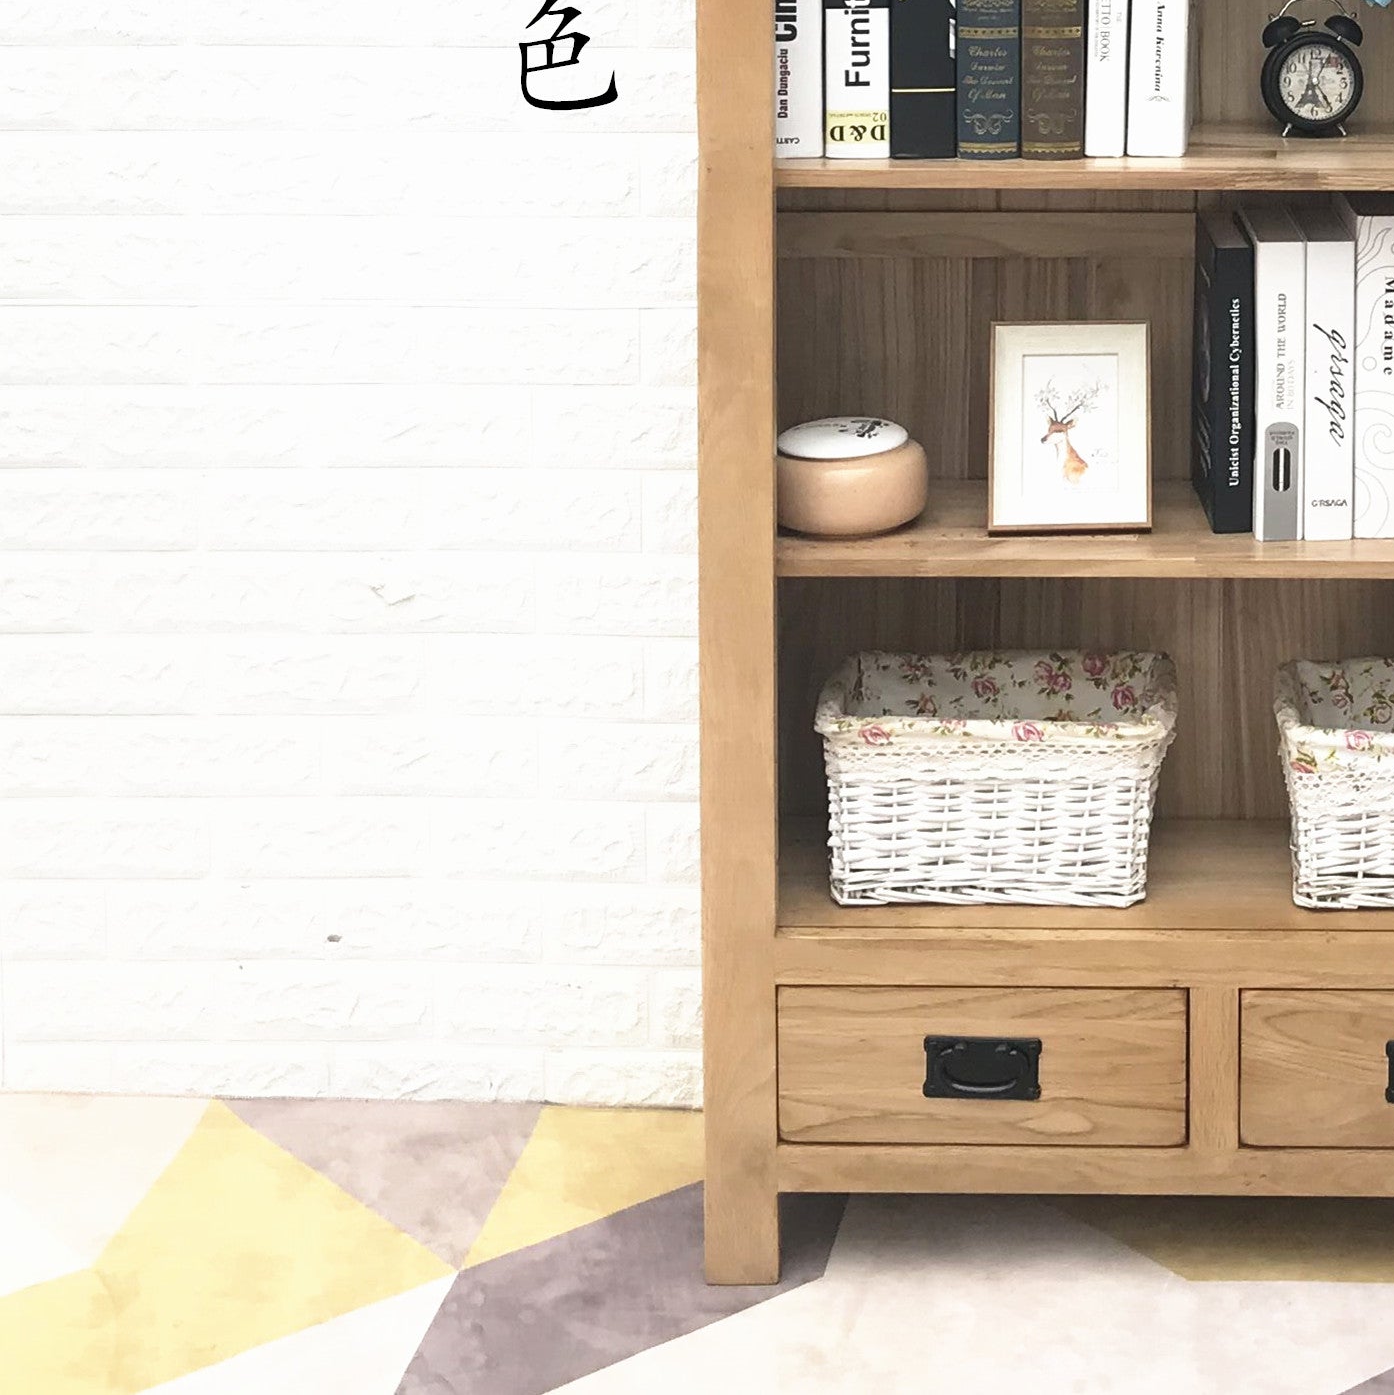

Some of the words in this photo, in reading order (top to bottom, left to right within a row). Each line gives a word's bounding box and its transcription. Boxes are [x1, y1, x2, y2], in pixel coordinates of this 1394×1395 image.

[777, 48, 791, 97] Dungaciu
[777, 98, 789, 119] Dan
[829, 125, 845, 142] D
[849, 124, 867, 143] &
[870, 124, 886, 142] D
[1229, 298, 1242, 362] Cybernetics
[1276, 292, 1287, 333] WORLD
[1276, 337, 1286, 358] THE
[1229, 364, 1242, 445] Organizational
[1275, 362, 1286, 410] AROUND
[1229, 447, 1240, 487] Unicist
